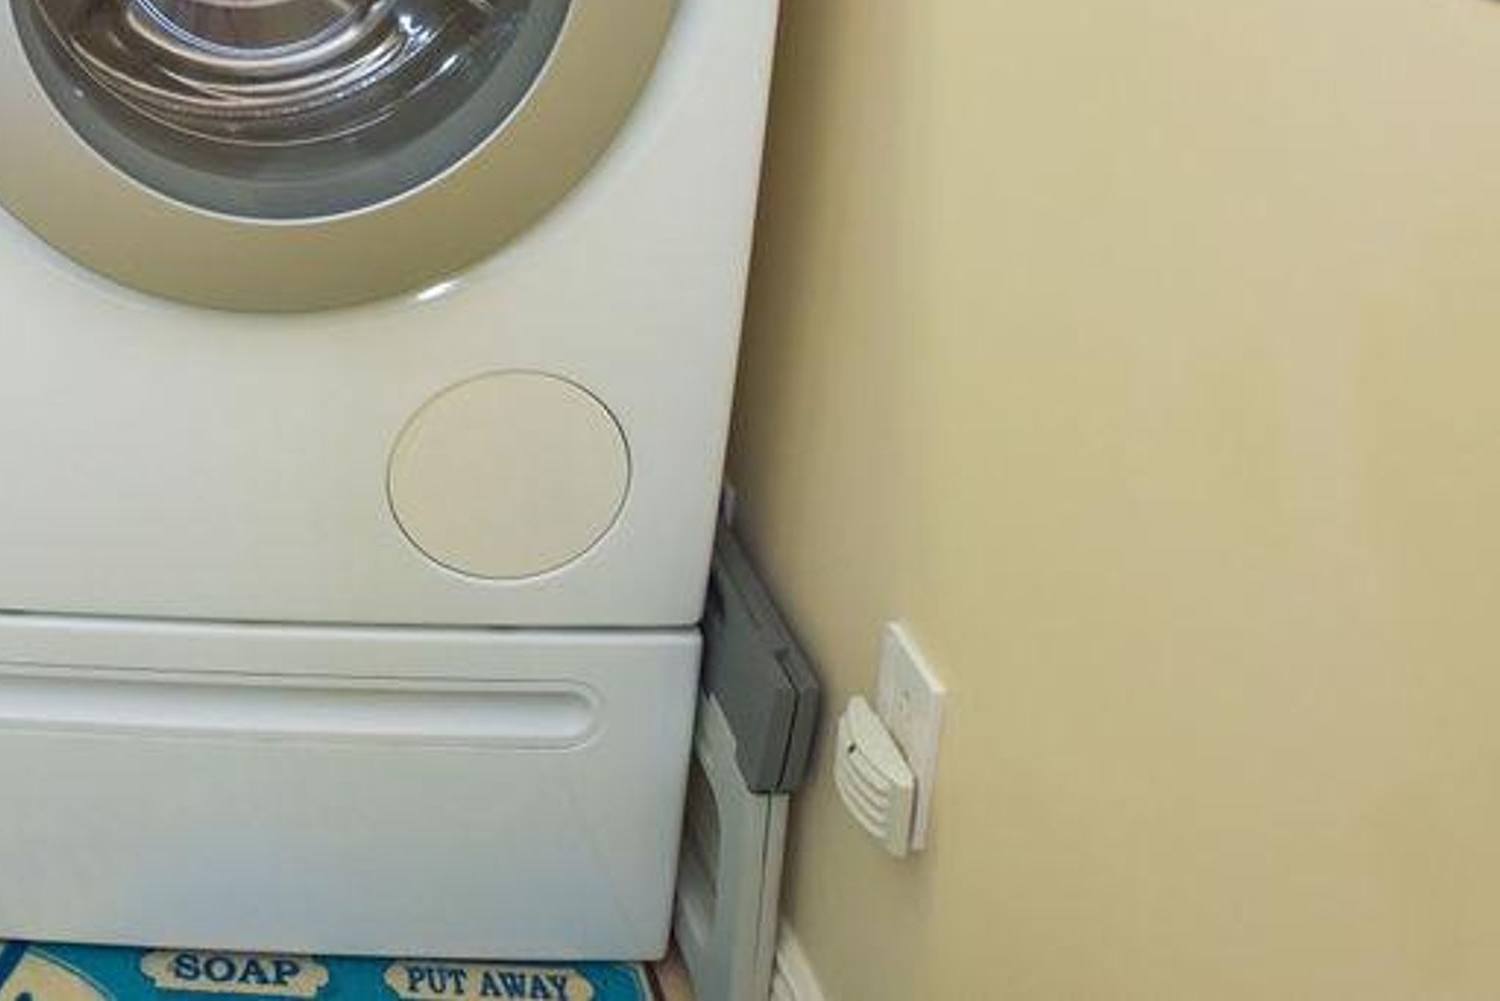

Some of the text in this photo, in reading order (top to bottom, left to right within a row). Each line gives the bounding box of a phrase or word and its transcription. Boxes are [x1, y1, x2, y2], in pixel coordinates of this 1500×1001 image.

[173, 953, 301, 987] SOAP
[406, 967, 570, 1001] PUT AWAY
